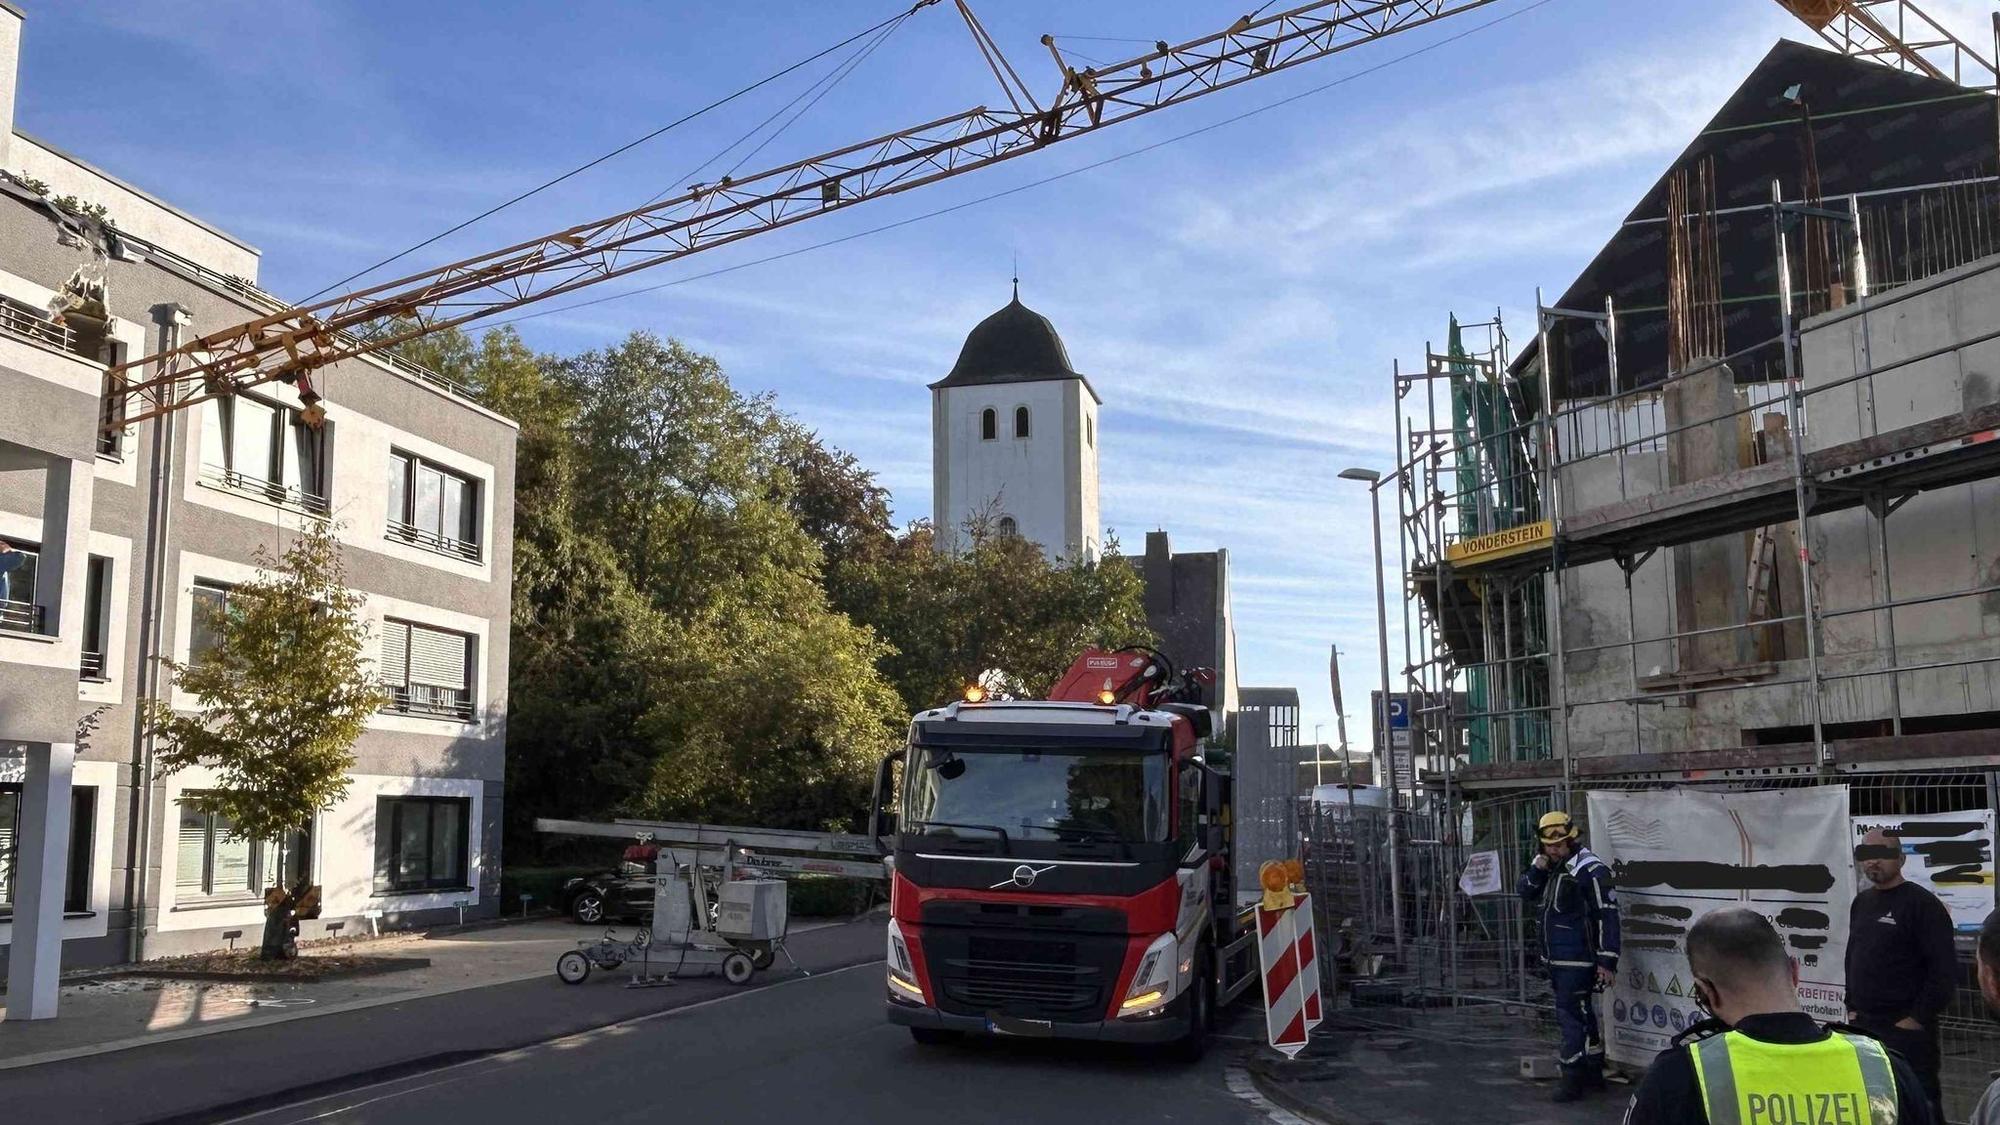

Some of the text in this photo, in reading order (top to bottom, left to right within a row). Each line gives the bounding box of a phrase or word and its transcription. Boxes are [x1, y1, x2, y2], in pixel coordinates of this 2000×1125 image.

[1463, 525, 1544, 554] VONDERSTEIN
[1797, 987, 1843, 1002] RBEITEN
[1747, 1093, 1862, 1125] POLIZEI
